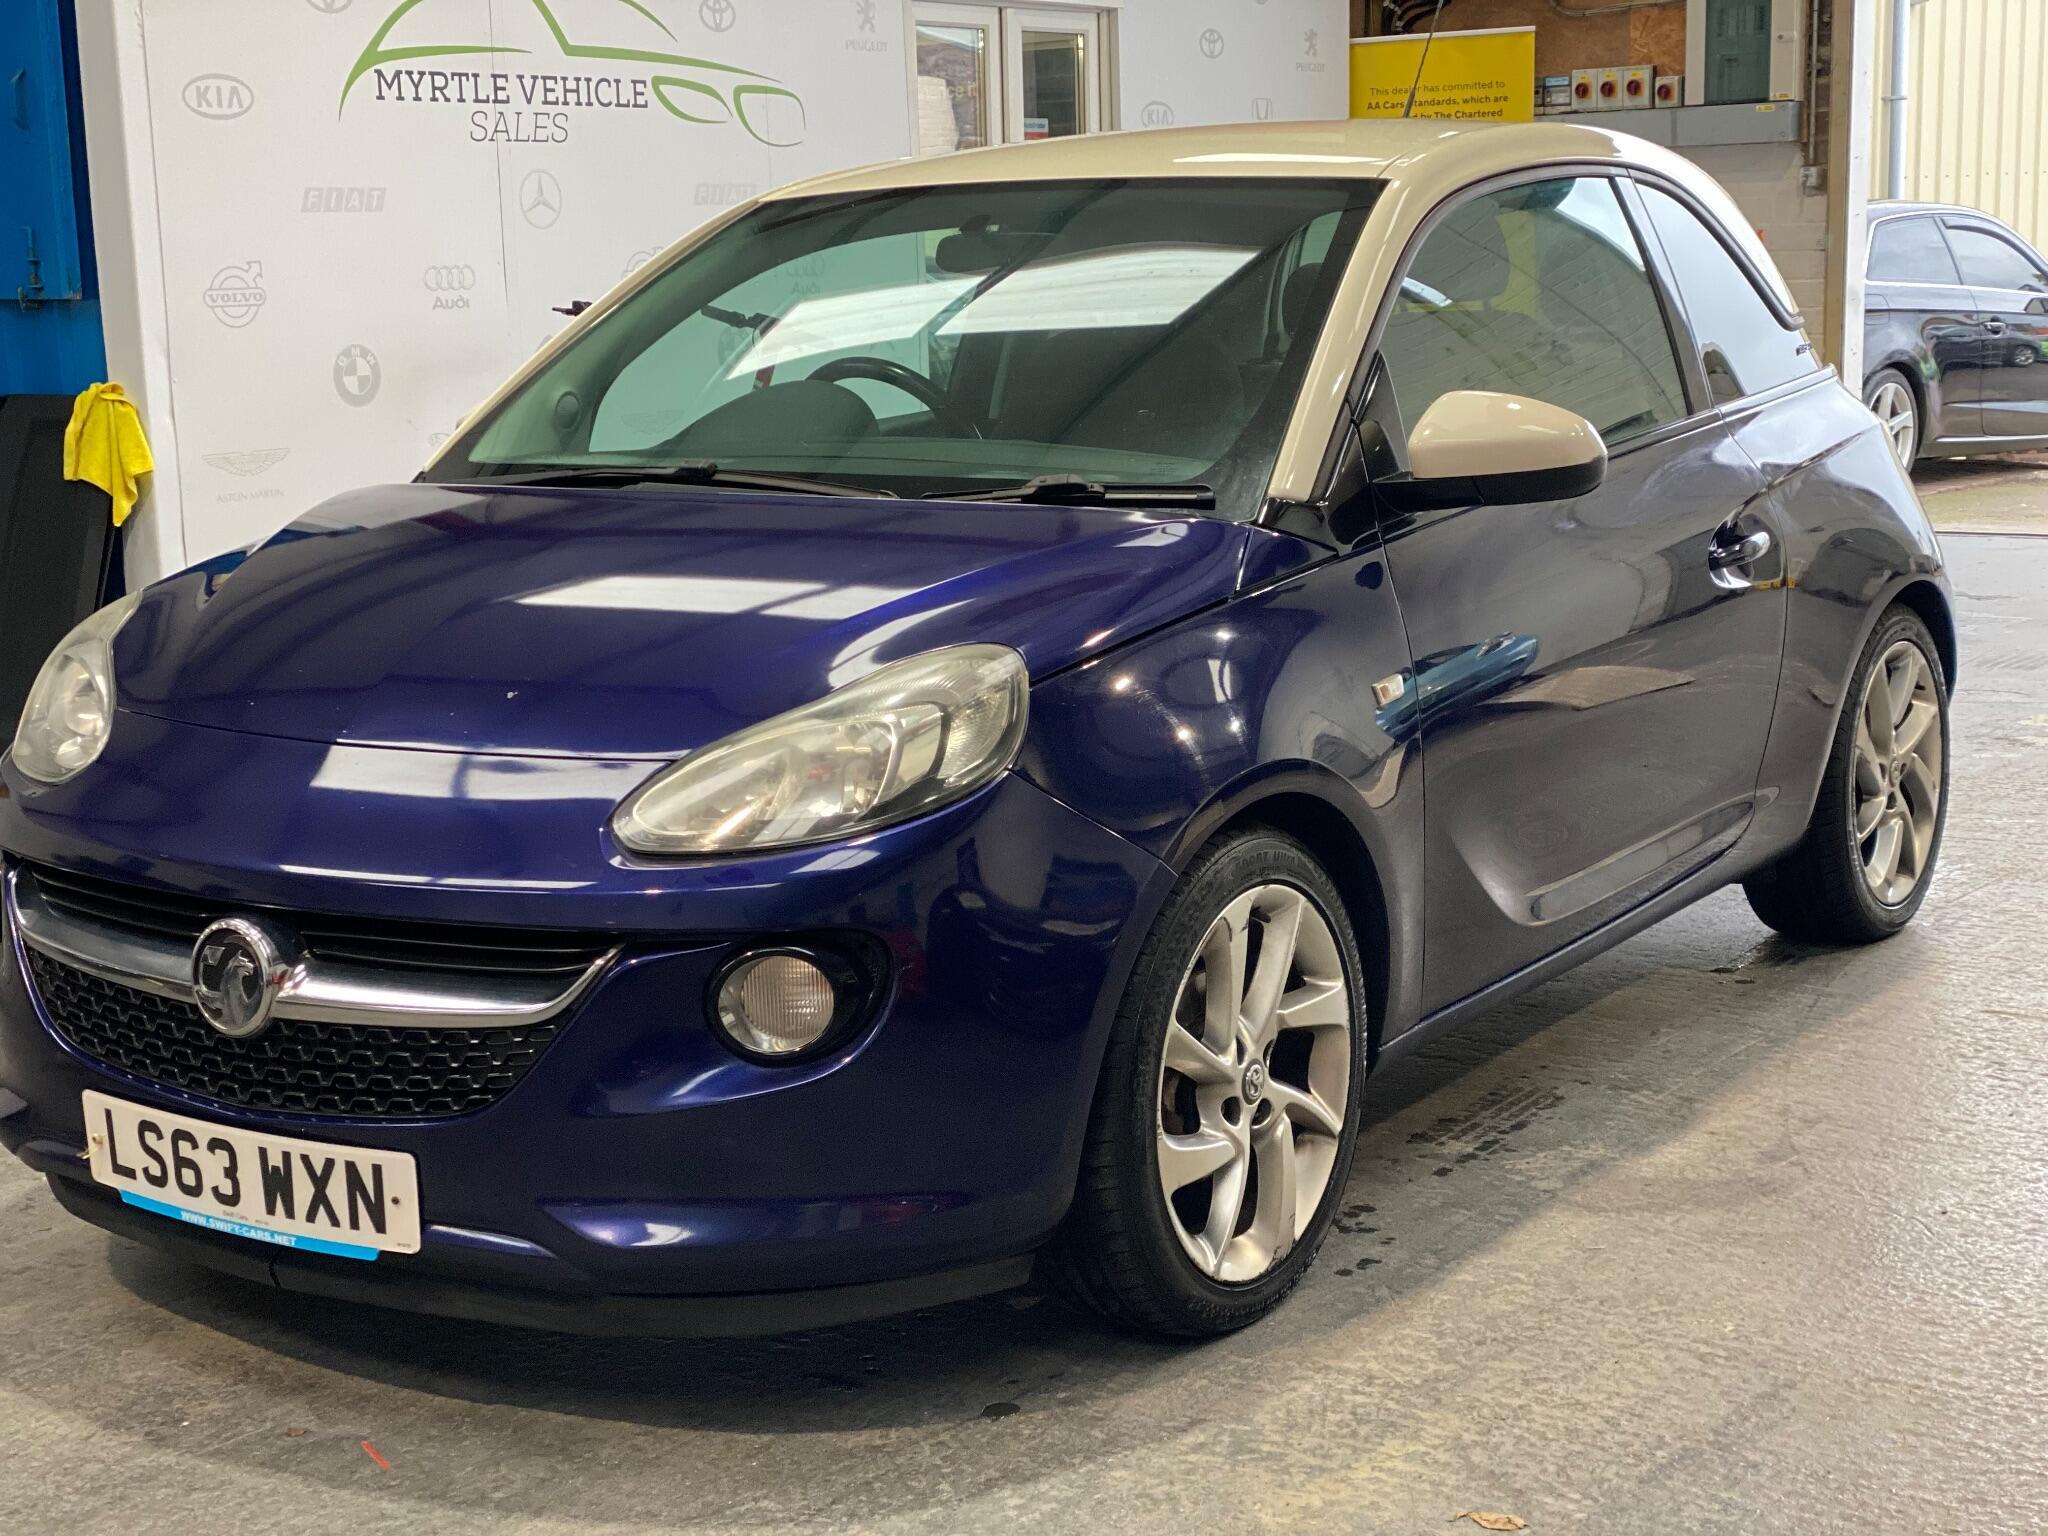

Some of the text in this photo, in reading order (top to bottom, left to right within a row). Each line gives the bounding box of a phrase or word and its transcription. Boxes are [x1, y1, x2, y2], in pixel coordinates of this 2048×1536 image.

[195, 84, 244, 109] KIA
[374, 68, 648, 108] MYRTLE VEHICLE
[1369, 80, 1506, 96] This dealr has committed to
[1367, 95, 1509, 110] AA Cars tandards, which are
[1454, 108, 1503, 119] Chartered
[470, 110, 569, 143] SALES
[303, 188, 386, 212] FIAT
[207, 292, 263, 303] VOLVO
[105, 1107, 388, 1235] LS63 WXN
[180, 1210, 298, 1247] WWW.SWIFT-CARS.NET
